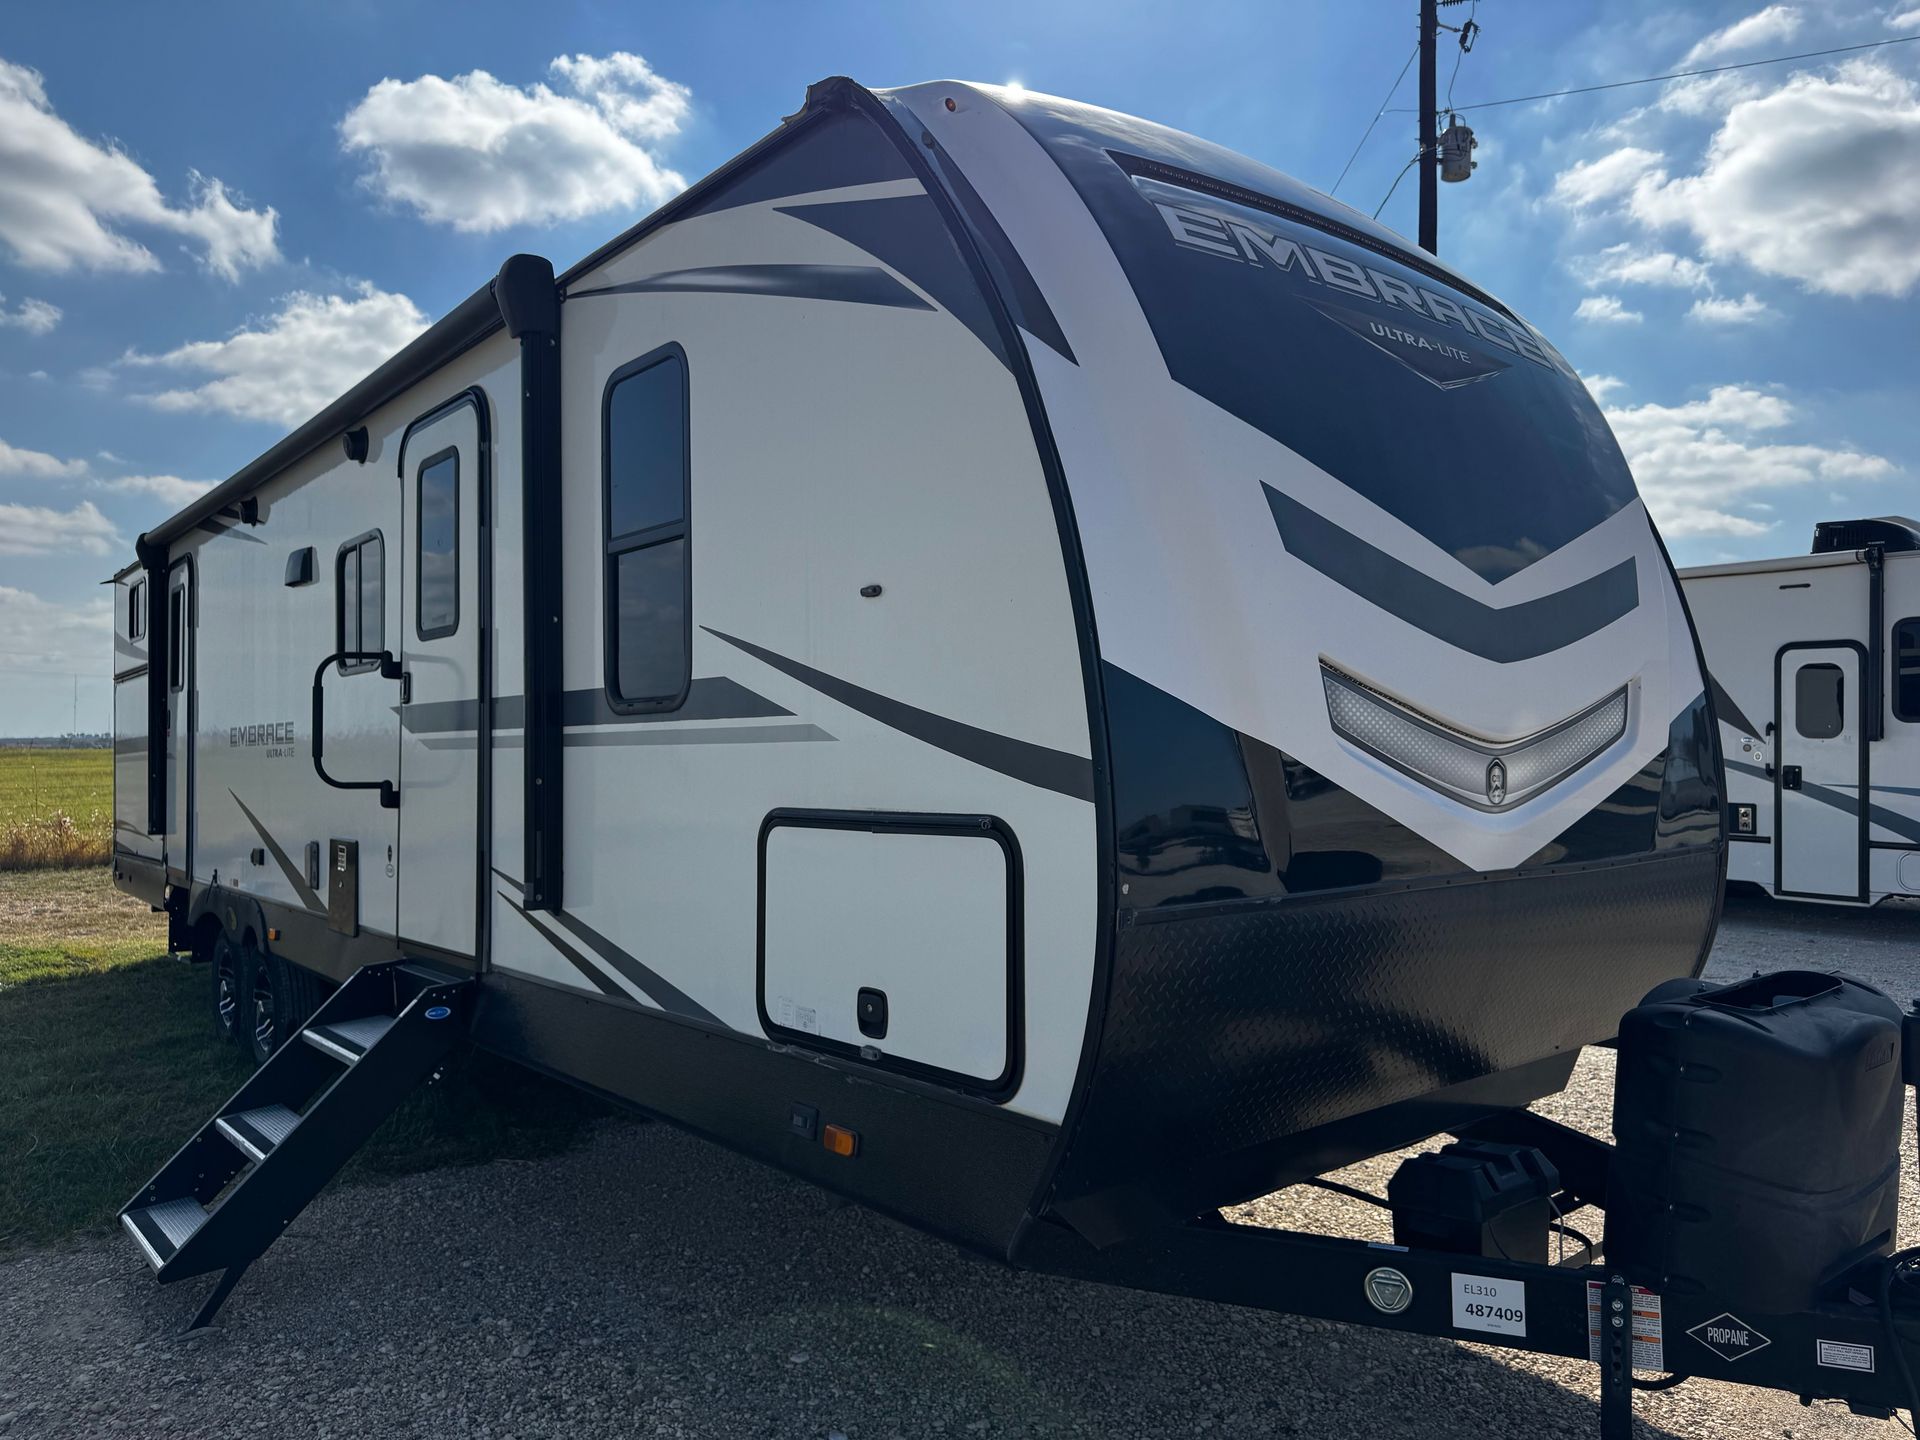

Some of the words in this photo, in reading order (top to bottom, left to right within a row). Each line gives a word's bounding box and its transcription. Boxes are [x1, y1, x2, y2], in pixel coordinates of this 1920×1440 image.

[1154, 202, 1556, 372] EMBRACE
[1369, 321, 1472, 365] ULTRA-LITE
[230, 721, 294, 747] EMBRACE
[1464, 1283, 1497, 1298] EL310
[1465, 1303, 1523, 1323] 487409
[1707, 1327, 1749, 1346] PROPANE
